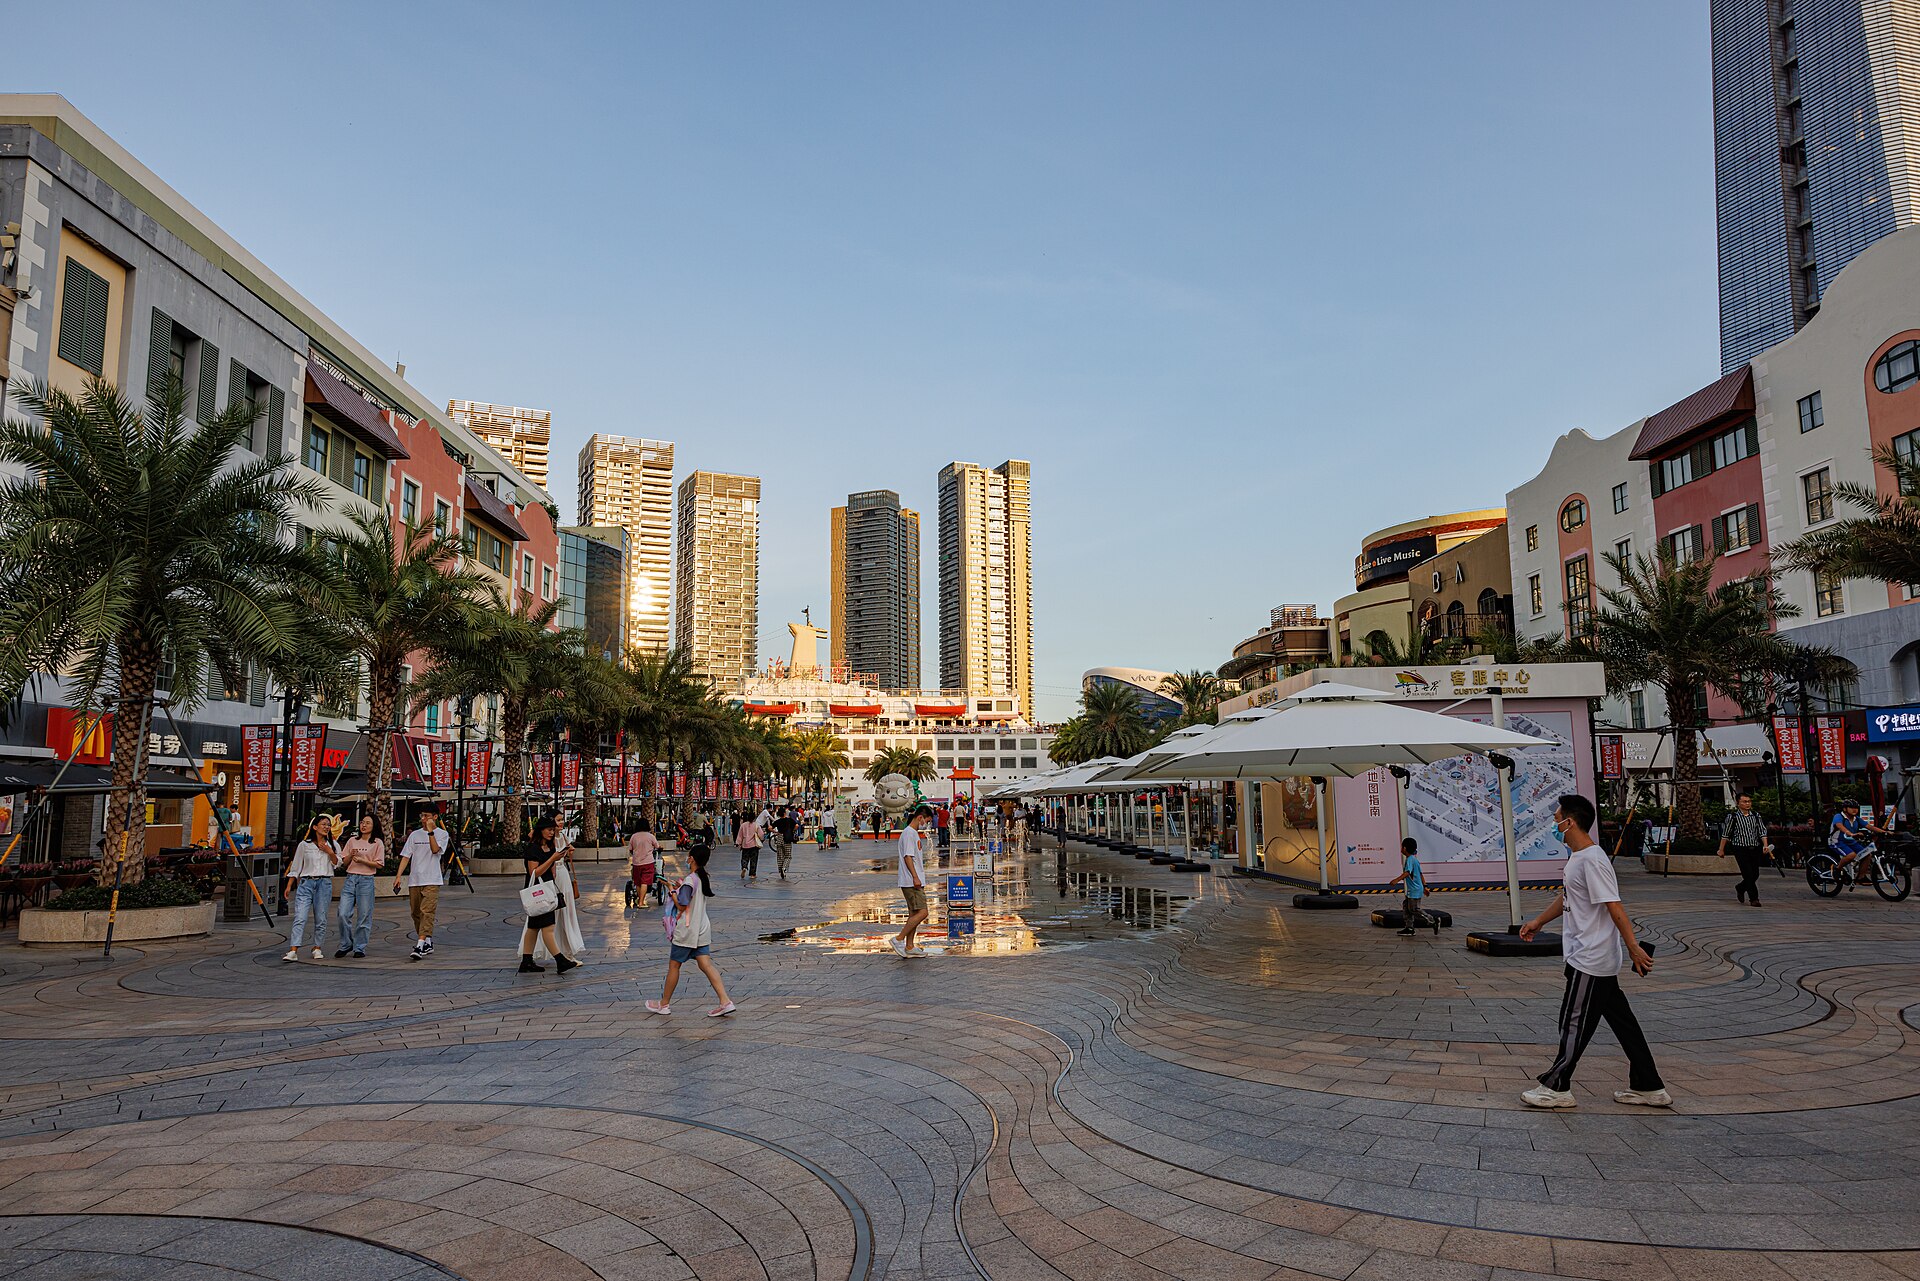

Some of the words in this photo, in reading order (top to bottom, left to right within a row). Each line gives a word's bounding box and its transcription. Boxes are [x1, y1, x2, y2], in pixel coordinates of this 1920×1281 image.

[1376, 556, 1392, 566] Live
[1393, 549, 1421, 562] Music
[1131, 674, 1156, 682] vivo
[1450, 668, 1531, 687] 客服中心
[1500, 687, 1529, 696] ERVICE
[149, 732, 182, 755] 当劳
[1850, 733, 1867, 742] BAR
[322, 748, 349, 768] KFC
[1368, 772, 1380, 816] 地图指南
